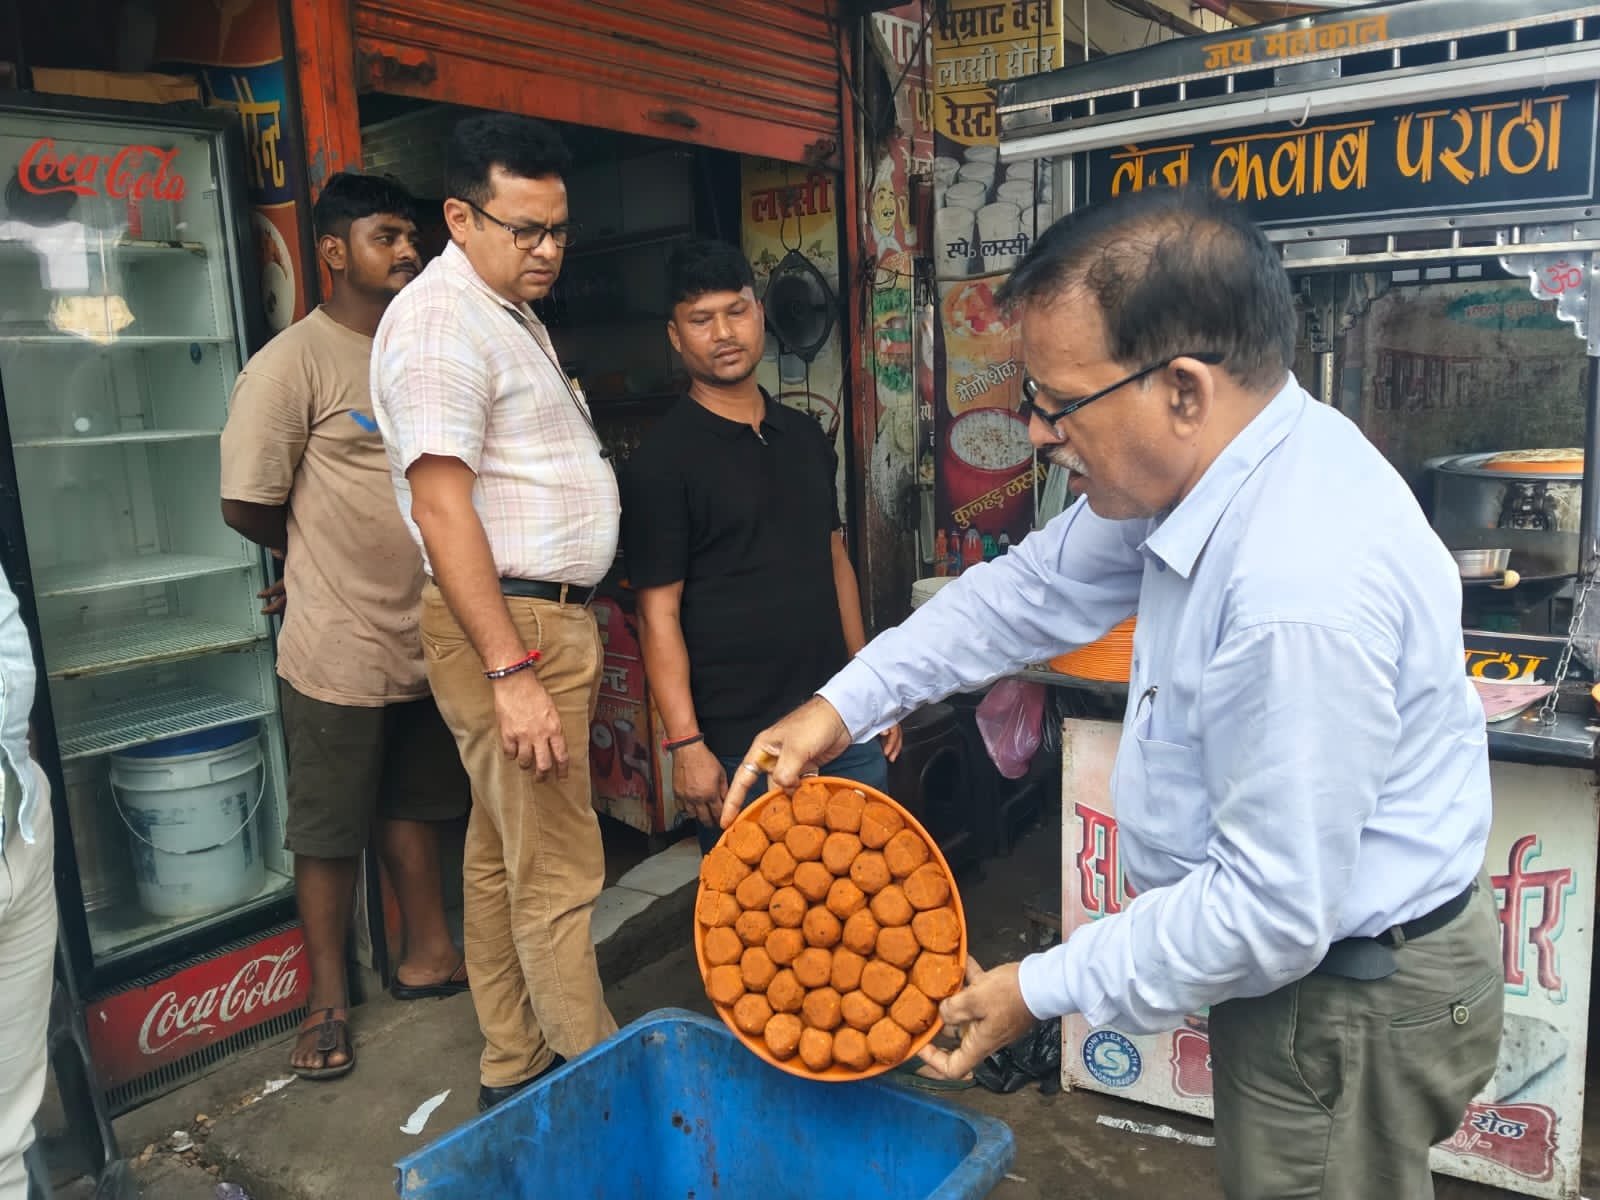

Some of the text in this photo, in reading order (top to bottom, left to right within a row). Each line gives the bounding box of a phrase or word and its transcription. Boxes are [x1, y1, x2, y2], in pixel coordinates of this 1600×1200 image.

[938, 5, 1006, 44] सम्राट
[1203, 15, 1389, 69] जय महाकाल
[936, 48, 1000, 87] लस्सी
[138, 944, 304, 1054] Coca-Cola
[1472, 1110, 1527, 1138] रोल
